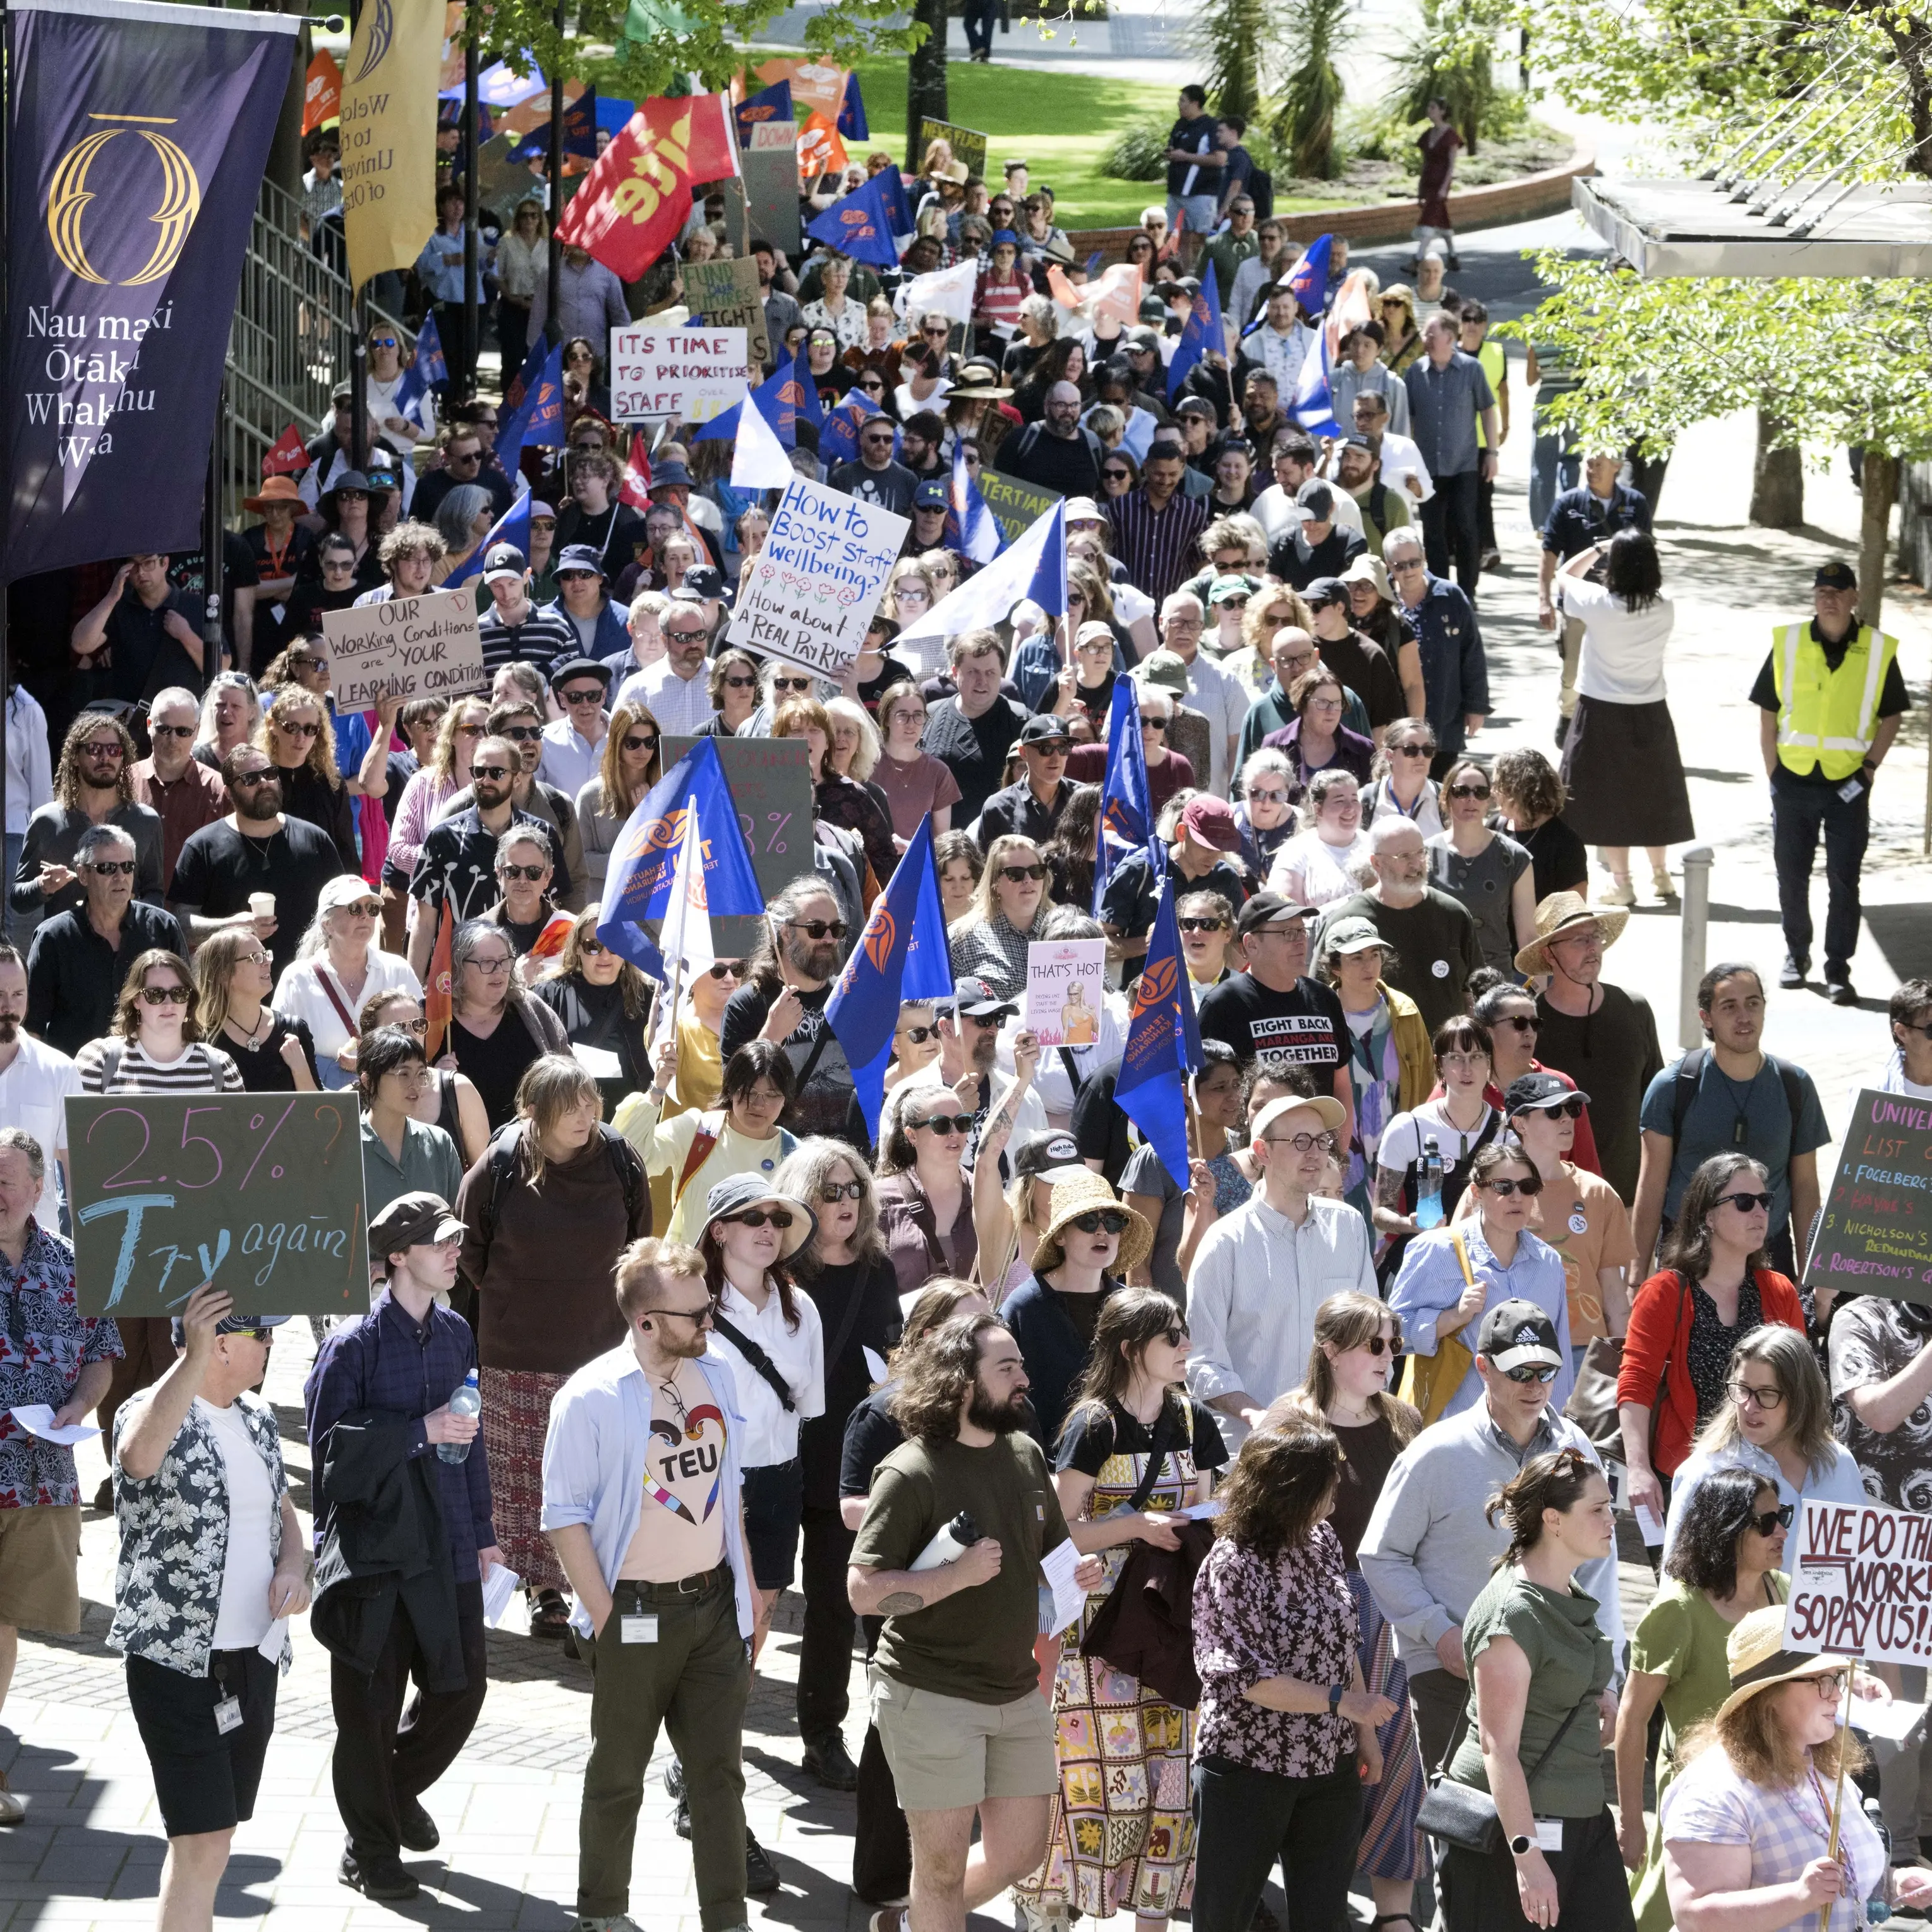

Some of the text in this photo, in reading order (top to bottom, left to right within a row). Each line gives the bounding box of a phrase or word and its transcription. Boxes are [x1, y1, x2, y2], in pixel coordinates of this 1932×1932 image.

[27, 306, 87, 337] Nau
[619, 335, 728, 354] ITS TIME
[618, 364, 747, 380] TO PRIORITISE
[615, 390, 682, 414] STAFF
[831, 416, 855, 439] TEU
[981, 473, 1054, 516] TERTIAR
[783, 481, 868, 538] How to
[170, 564, 184, 577] BIG
[379, 594, 468, 625] OUR D
[738, 608, 749, 623] A
[751, 614, 790, 647] REAL
[792, 631, 818, 660] PAY
[790, 608, 849, 637] about
[361, 642, 447, 669] are YOUR
[1031, 962, 1102, 979] THAT'S HOT
[1252, 1018, 1330, 1034] FIGHT BACK
[1254, 1034, 1316, 1048] MARANGA
[1261, 1047, 1337, 1063] TOGETHER
[1050, 1145, 1062, 1153] High
[1863, 1135, 1909, 1158] LIST
[1843, 1163, 1852, 1175] 1.
[1843, 1219, 1928, 1246] NICHOLSON'S
[78, 1194, 231, 1311] Try
[1811, 1253, 1825, 1271] 4.
[1829, 1252, 1915, 1279] ROBERTSON'S
[1515, 1335, 1540, 1343] adidas
[659, 1444, 718, 1482] TEU
[1808, 1507, 1857, 1555] WE
[1858, 1510, 1895, 1559] DO
[1791, 1593, 1827, 1641] SO
[1825, 1595, 1876, 1648] PAY
